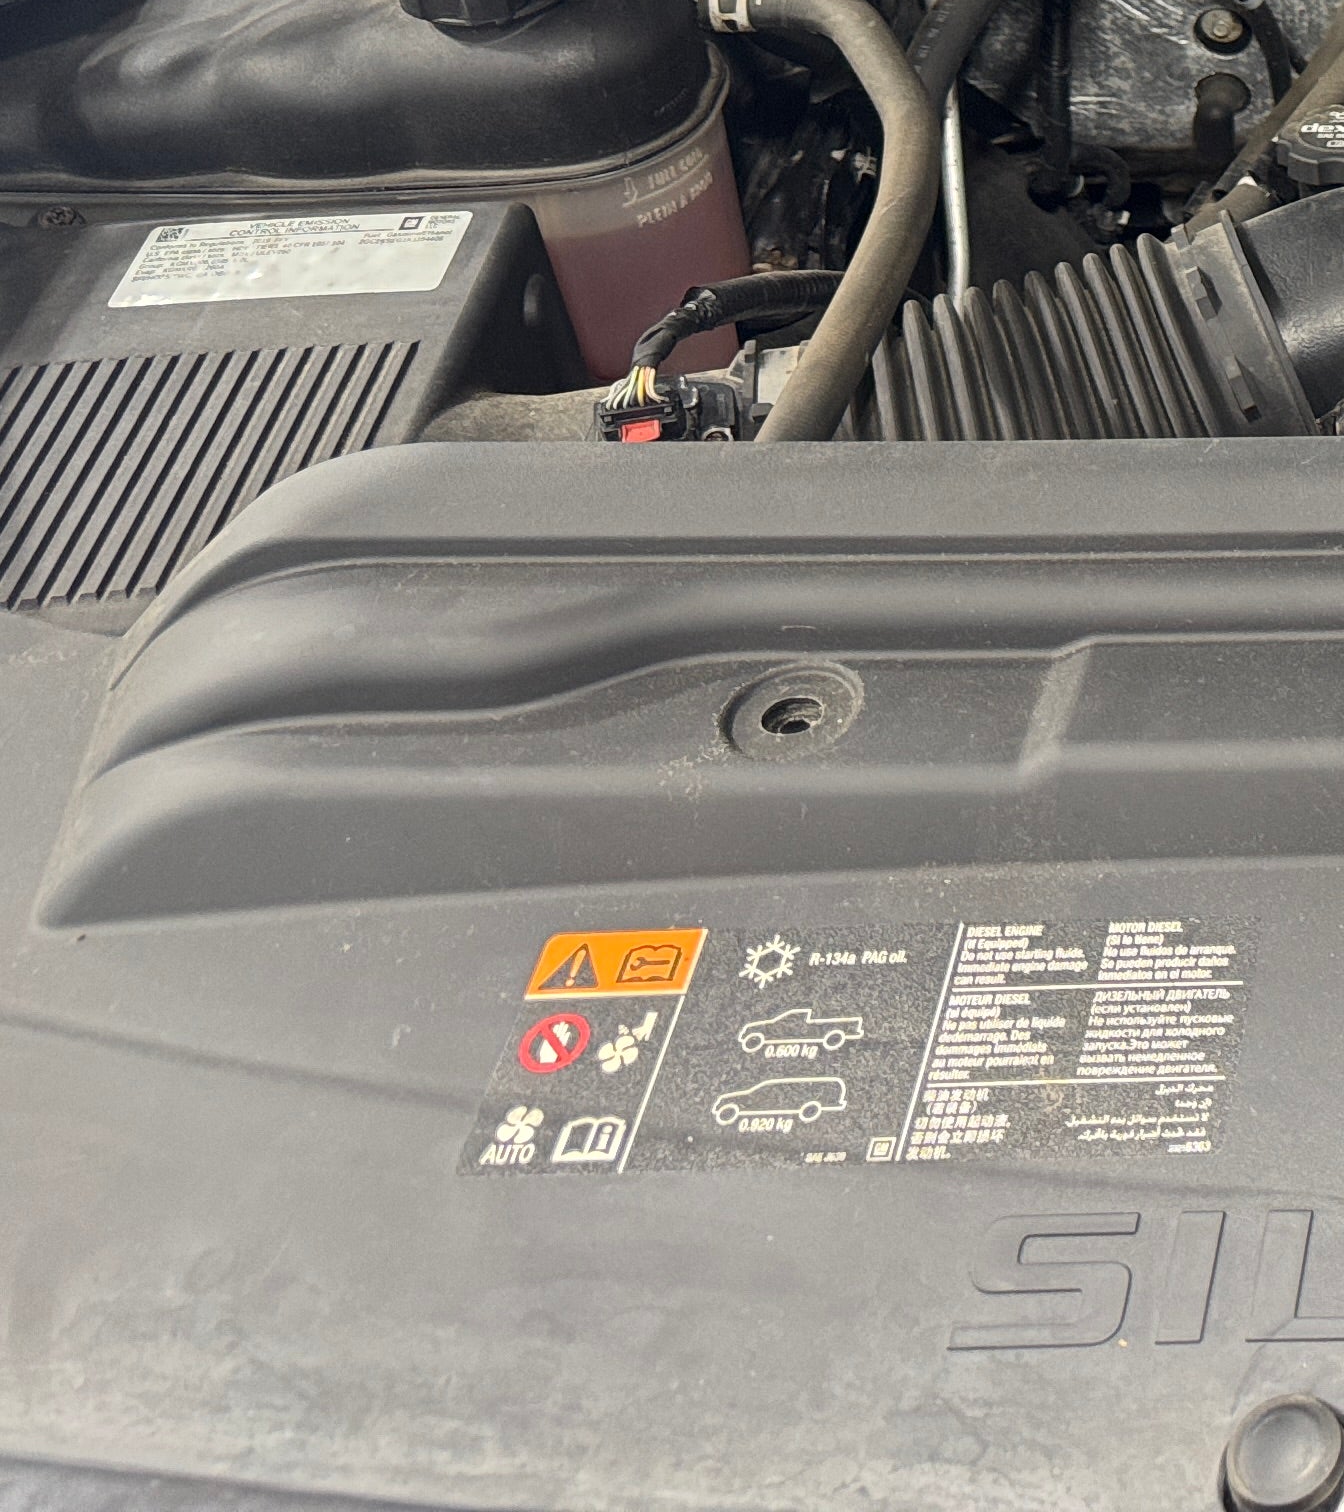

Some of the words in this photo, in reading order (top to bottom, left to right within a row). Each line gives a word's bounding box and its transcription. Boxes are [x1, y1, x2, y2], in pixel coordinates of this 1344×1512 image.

[967, 926, 1003, 937] DIESEL
[1004, 924, 1044, 937] ENGINE
[1108, 921, 1147, 934] MOTOR
[1147, 920, 1184, 933] DIESEL
[808, 950, 857, 966] R-134a
[861, 950, 889, 965] PAG
[948, 994, 993, 1006] MOTEUR
[994, 993, 1031, 1005] DIESEL
[1093, 989, 1165, 1002] ДИЗЕЛЬНЫЙ
[1165, 988, 1231, 1001] ДВИГАТЕЛЬ
[1088, 1016, 1105, 1026] Не
[764, 1044, 800, 1059] 0.600
[800, 1044, 819, 1060] kg
[738, 1118, 775, 1134] 0.920
[776, 1117, 794, 1135] kg
[478, 1142, 536, 1166] AUTO
